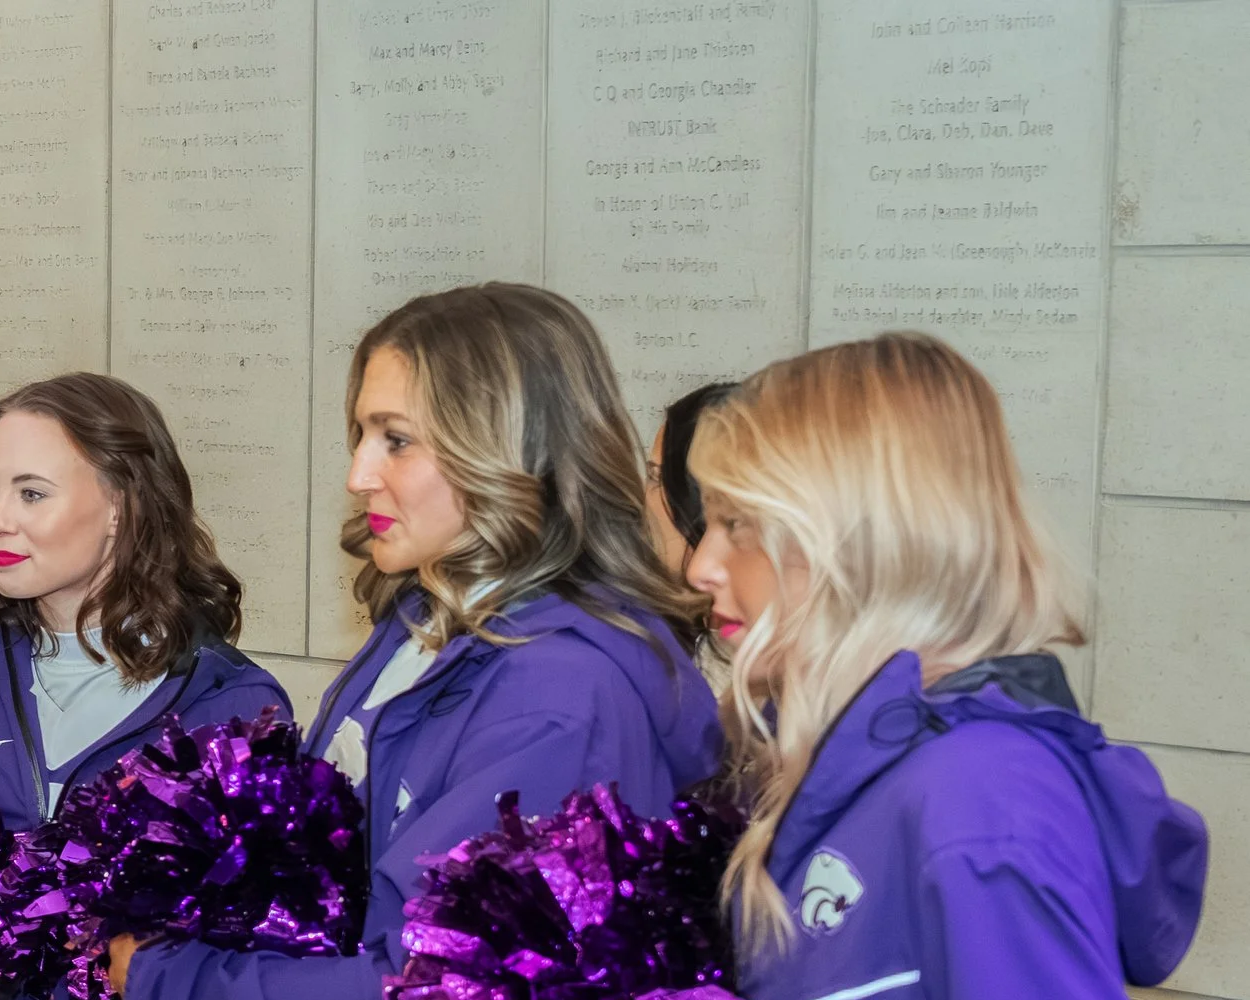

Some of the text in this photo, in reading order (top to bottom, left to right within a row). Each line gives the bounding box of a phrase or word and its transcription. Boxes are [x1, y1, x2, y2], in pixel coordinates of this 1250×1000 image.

[870, 11, 1056, 40] John and Colleen Harrison
[395, 43, 415, 59] and
[646, 45, 668, 63] and
[671, 44, 699, 63] Jane
[927, 57, 954, 76] Mel
[621, 83, 644, 101] and
[648, 82, 696, 104] Georgia
[700, 78, 758, 98] Chandler
[890, 93, 1030, 117] The Schrader Family
[627, 117, 718, 138] INTRUST Bank
[1017, 119, 1054, 138] Dave
[585, 154, 762, 180] George and Ann McCandless
[868, 159, 1049, 186] Gary and Sharon Younger
[653, 194, 664, 212] of
[876, 200, 1039, 222] Jim and Jeanne Baldwin
[874, 243, 896, 260] and
[897, 242, 927, 262] Jean
[935, 284, 959, 300] and
[902, 306, 925, 323] and
